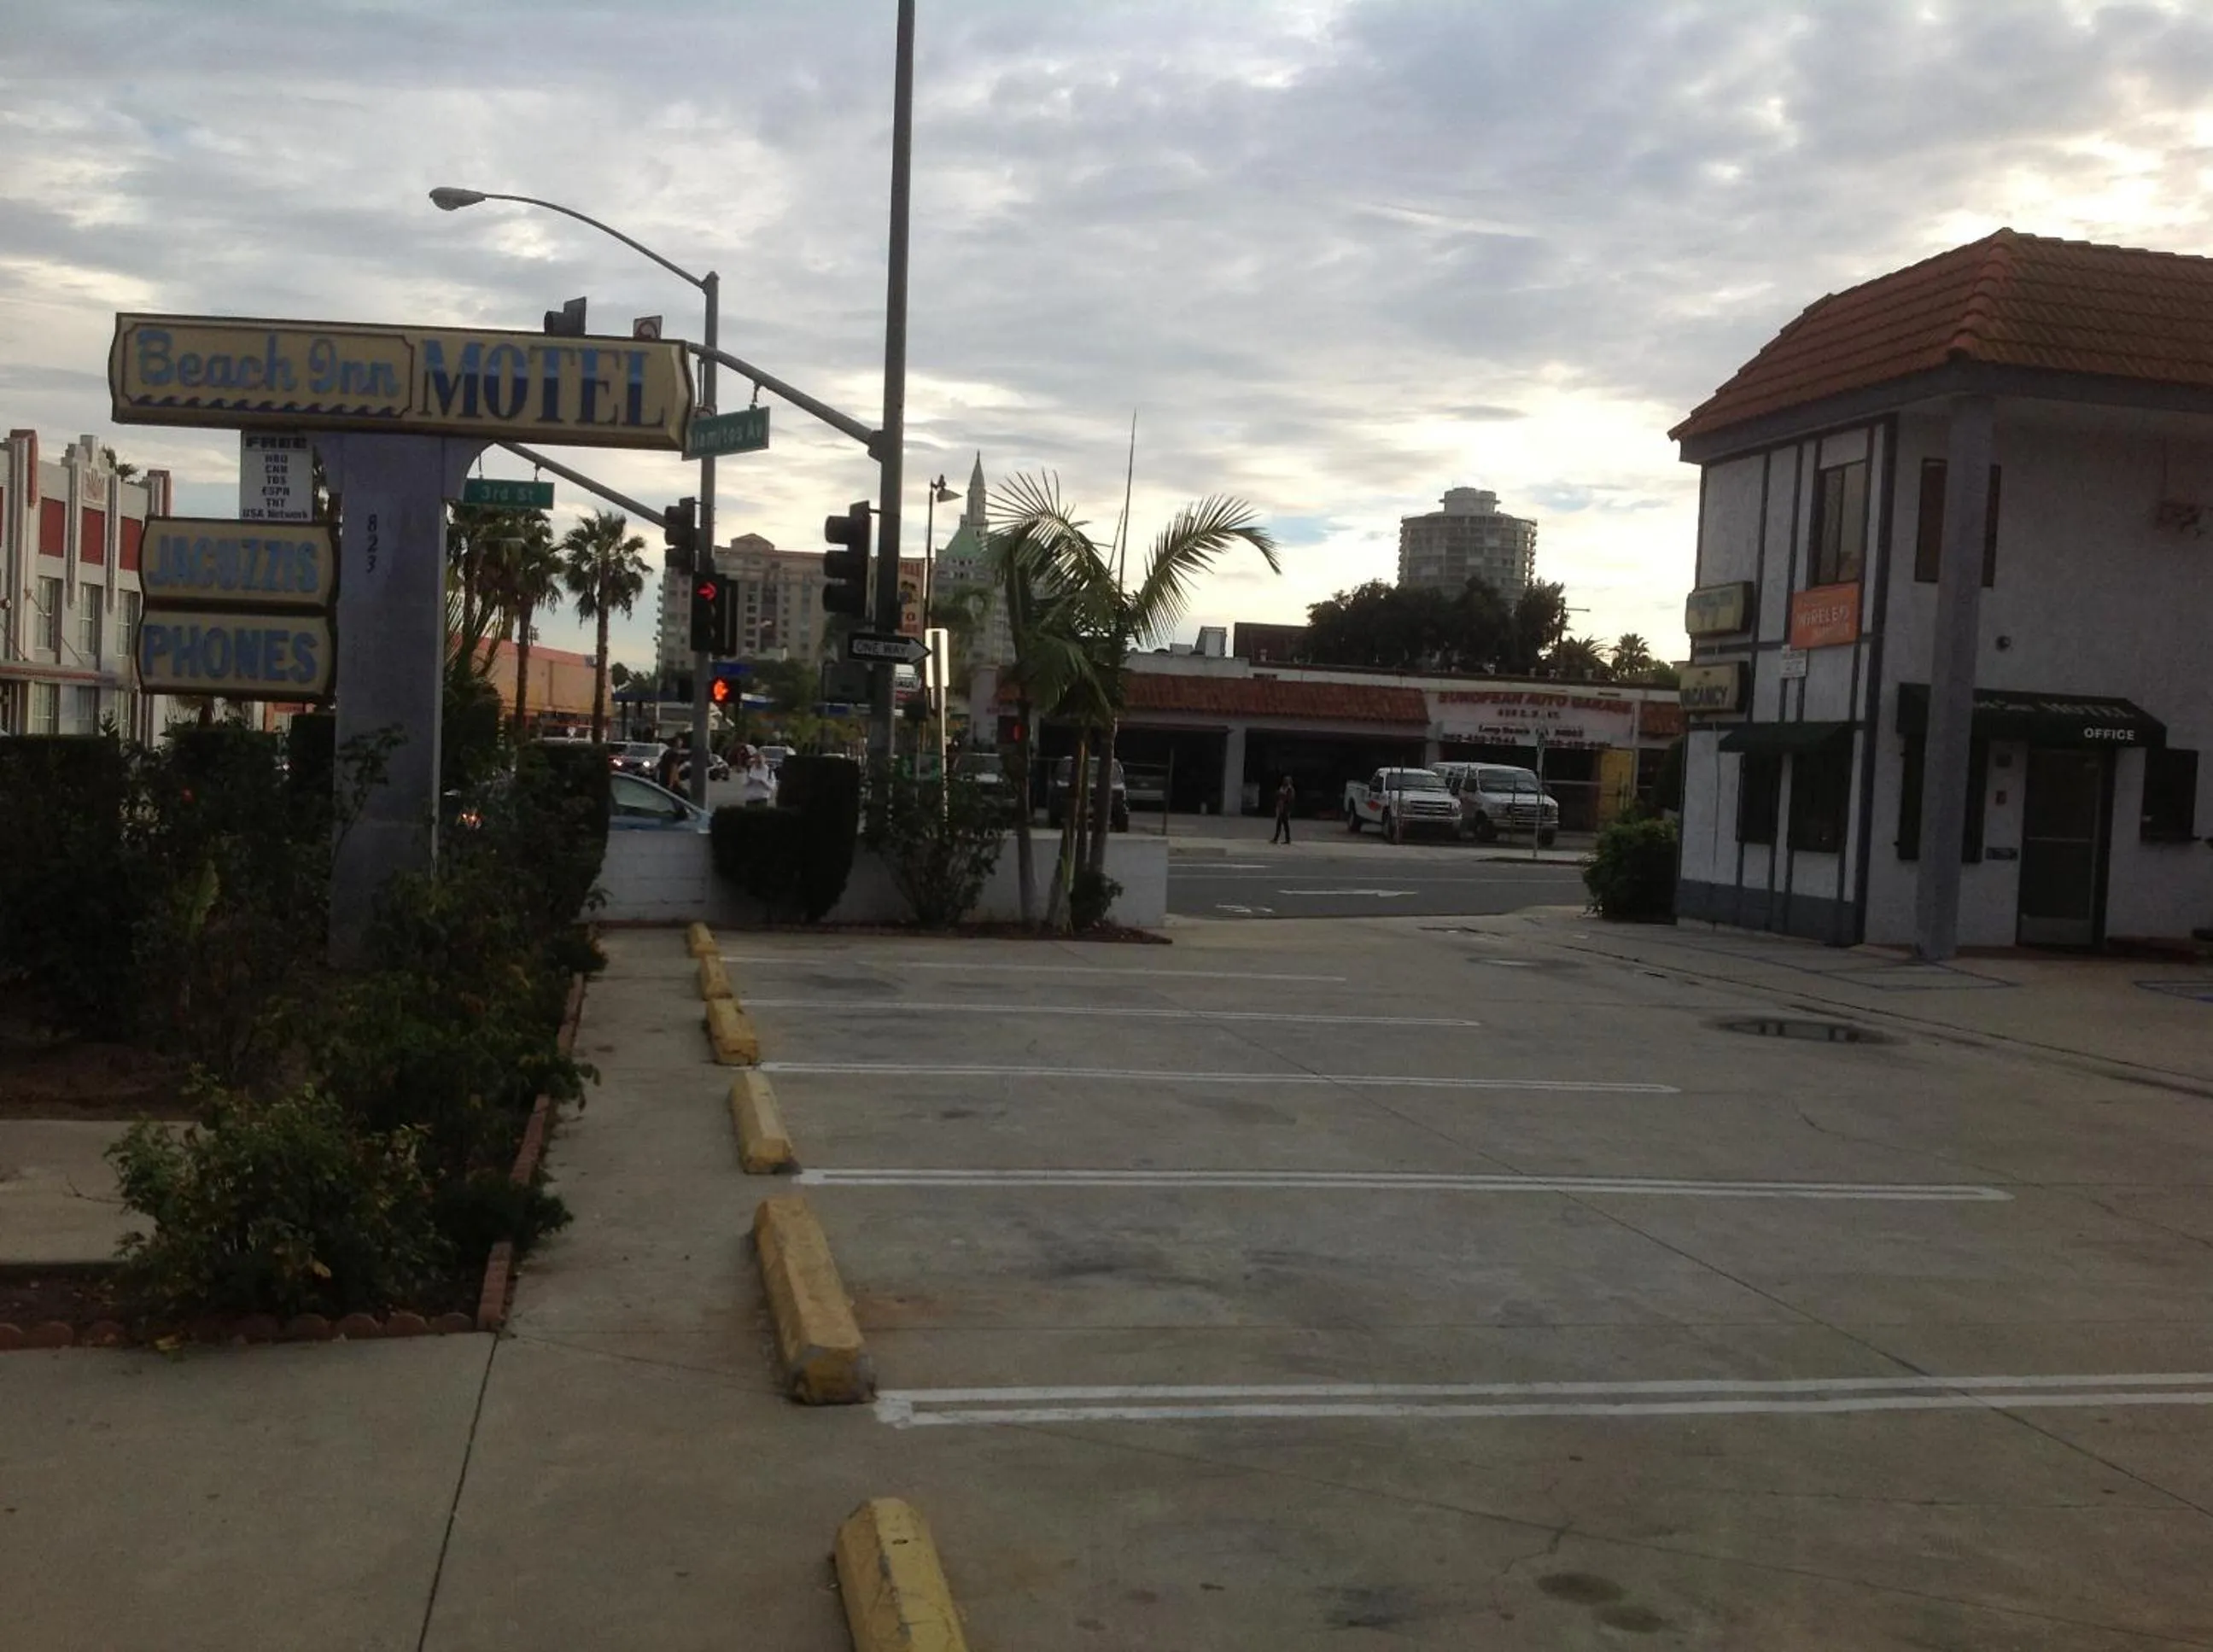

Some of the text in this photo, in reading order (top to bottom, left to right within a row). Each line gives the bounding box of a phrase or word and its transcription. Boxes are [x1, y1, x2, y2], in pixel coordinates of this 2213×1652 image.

[136, 329, 401, 397] Beach Inn
[418, 337, 665, 429] MOTEL
[265, 453, 289, 463] HBO
[265, 464, 289, 474] CNN
[261, 486, 290, 496] ESPN
[480, 484, 534, 502] 3rd St
[266, 498, 286, 507] TNT
[242, 508, 265, 518] USA
[148, 534, 320, 593] JACUZZIS
[142, 624, 318, 684] PHONES
[855, 640, 907, 655] ONE WAY
[1439, 692, 1522, 705] EUROPEAN
[1527, 692, 1568, 707] AUTO
[2083, 727, 2135, 741] OFFICE
